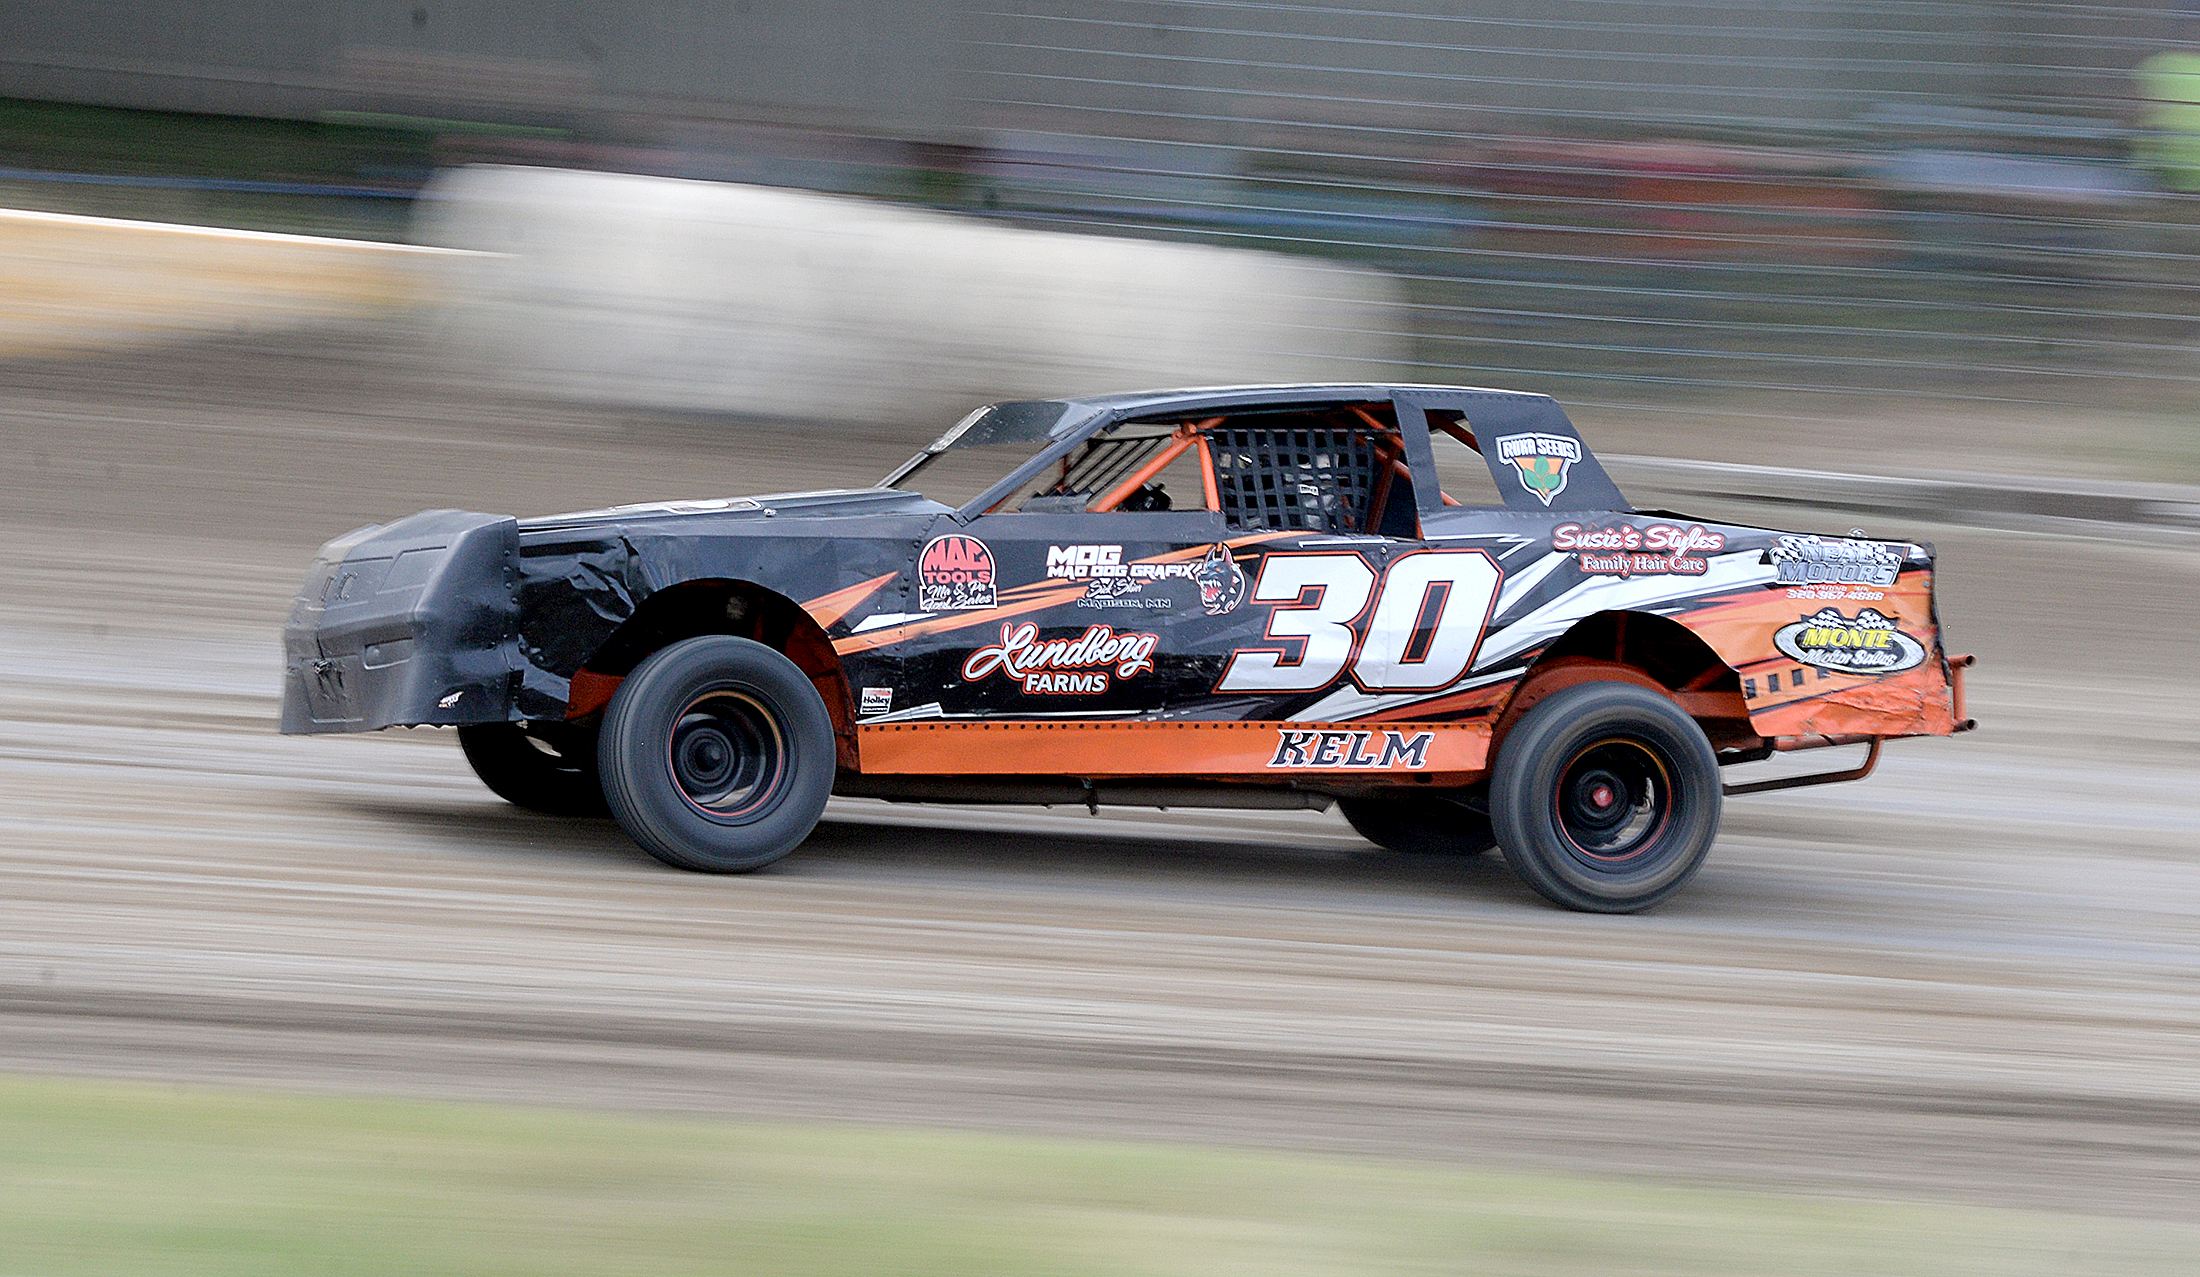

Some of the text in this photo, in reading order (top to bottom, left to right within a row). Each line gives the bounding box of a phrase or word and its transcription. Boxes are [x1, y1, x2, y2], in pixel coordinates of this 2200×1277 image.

[1502, 438, 1576, 459] RUKA SEEDS
[1554, 523, 1724, 557] Susie's Styles
[923, 537, 991, 571] MAC
[1129, 563, 1195, 580] GRAFIX
[1582, 556, 1705, 574] Family Hair Care
[1780, 560, 1897, 586] MOTORS
[924, 571, 991, 584] TOOLS
[953, 582, 967, 596] &
[1145, 598, 1172, 609] MN
[1212, 549, 1504, 694] 30
[1802, 628, 1893, 649] MONTE
[963, 623, 1158, 681] Lundberg
[1802, 648, 1852, 664] Motor
[1023, 673, 1108, 693] FARMS
[863, 694, 890, 706] Holley
[1266, 729, 1435, 770] KELM
